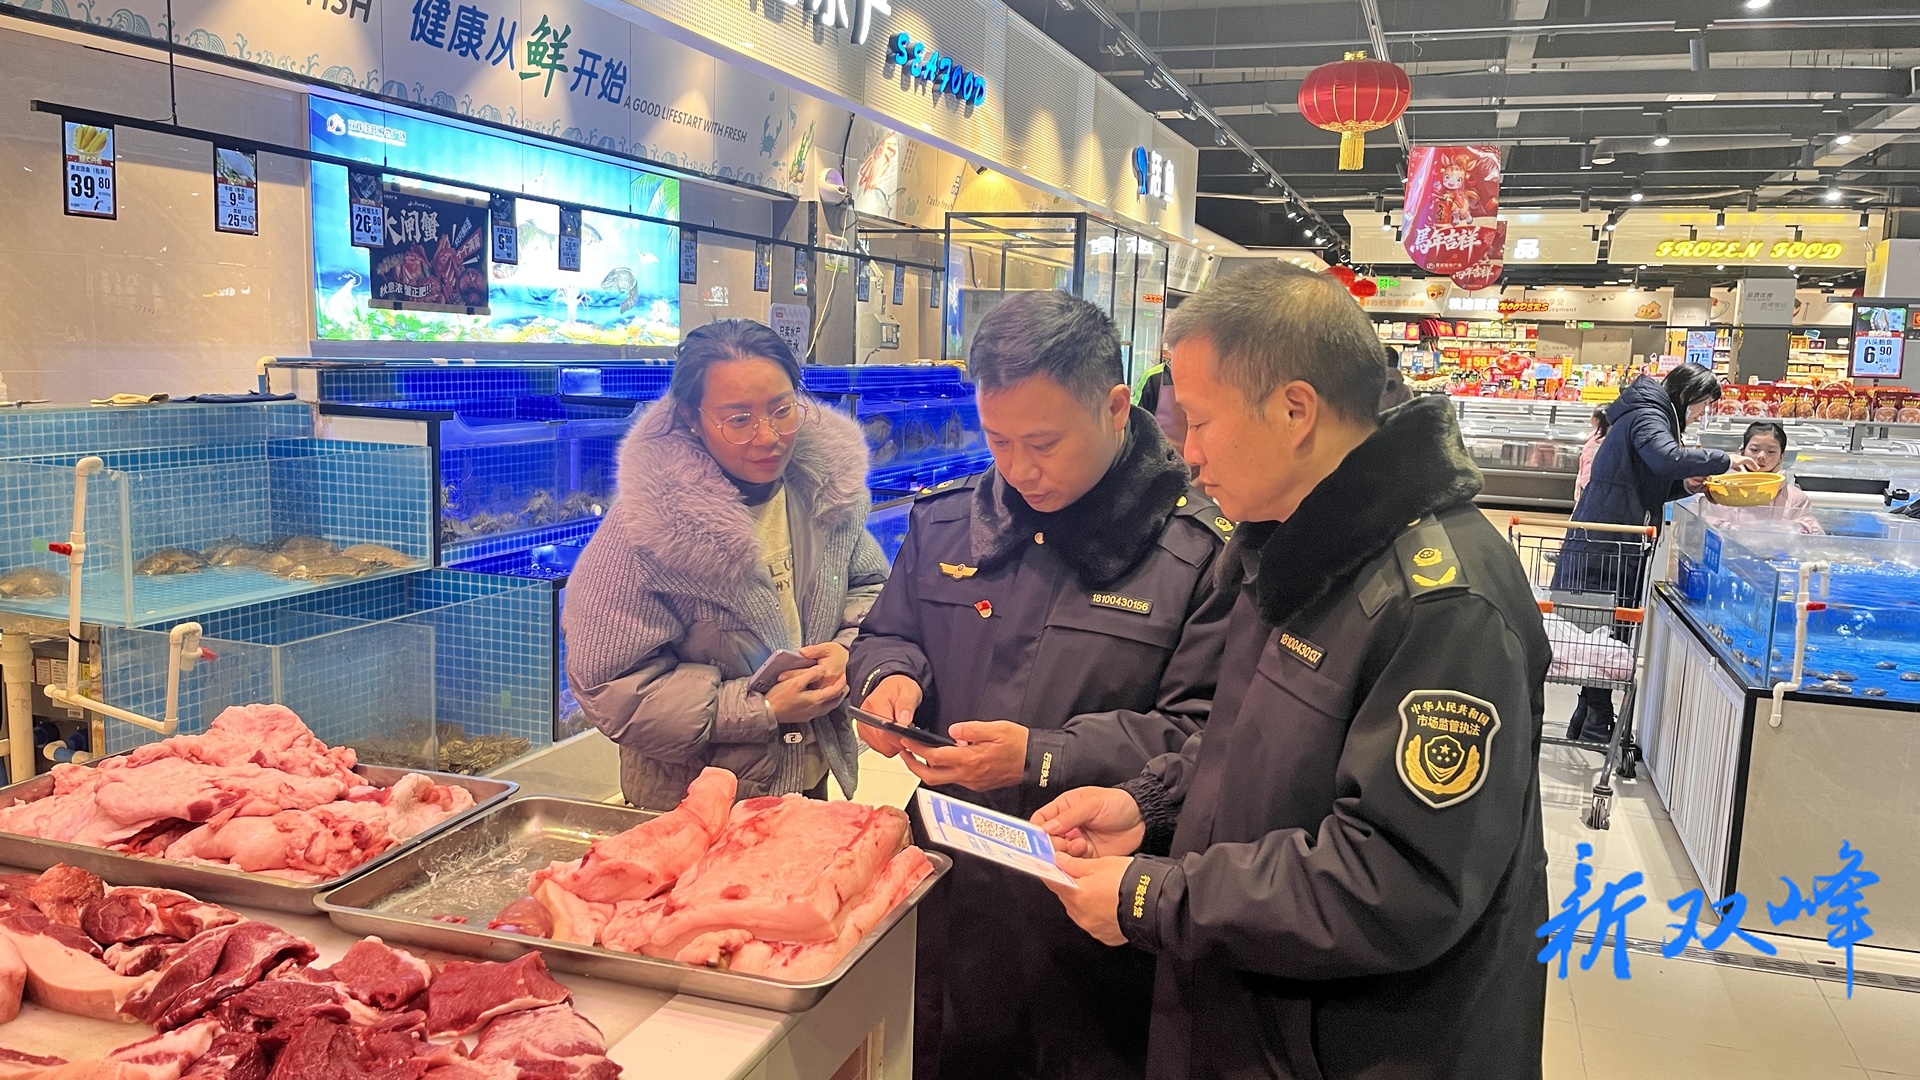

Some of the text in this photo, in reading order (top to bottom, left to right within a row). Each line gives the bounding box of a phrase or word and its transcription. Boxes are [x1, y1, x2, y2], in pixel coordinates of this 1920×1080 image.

[411, 0, 627, 103] 健康从鲜开始
[895, 31, 986, 107] SEAFOOD
[623, 95, 631, 109] A
[632, 98, 661, 117] GOOD
[703, 118, 724, 136] WITH
[724, 126, 748, 143] FRESH
[1655, 241, 1843, 260] FROZEN FOOD
[1092, 593, 1149, 611] 18100430156
[1280, 632, 1323, 664] 18100430137
[1410, 700, 1490, 727] 中华人民共和国
[1416, 714, 1481, 737] 市场监管执法
